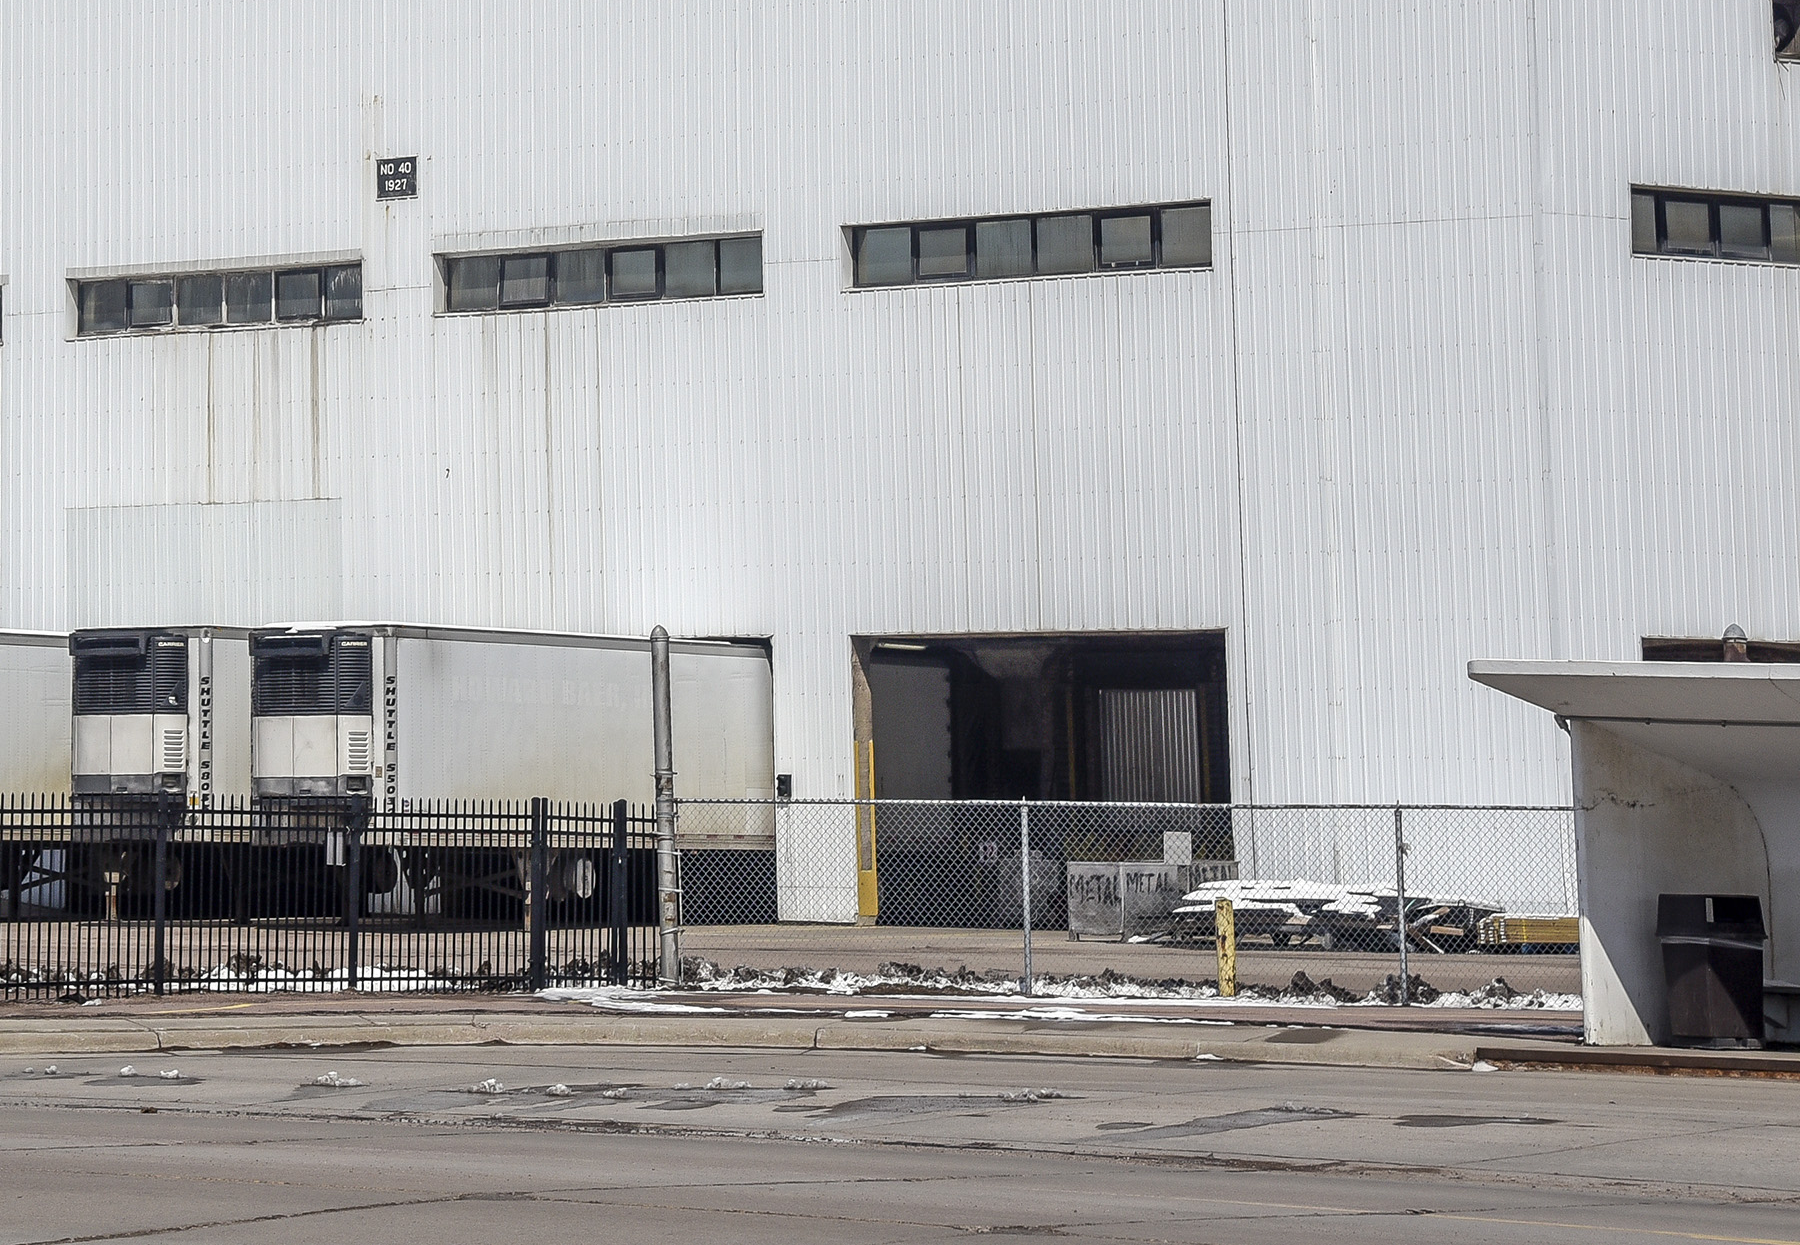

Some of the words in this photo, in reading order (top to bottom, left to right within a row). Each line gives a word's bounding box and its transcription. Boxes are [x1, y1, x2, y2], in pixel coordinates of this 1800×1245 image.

[380, 163, 394, 176] NO
[398, 161, 412, 174] 40
[385, 179, 407, 192] 1927
[201, 676, 211, 750] SHUTTLE
[386, 675, 396, 751] SHUTTLE
[1069, 874, 1121, 906] METAL
[1126, 872, 1169, 894] METAL
